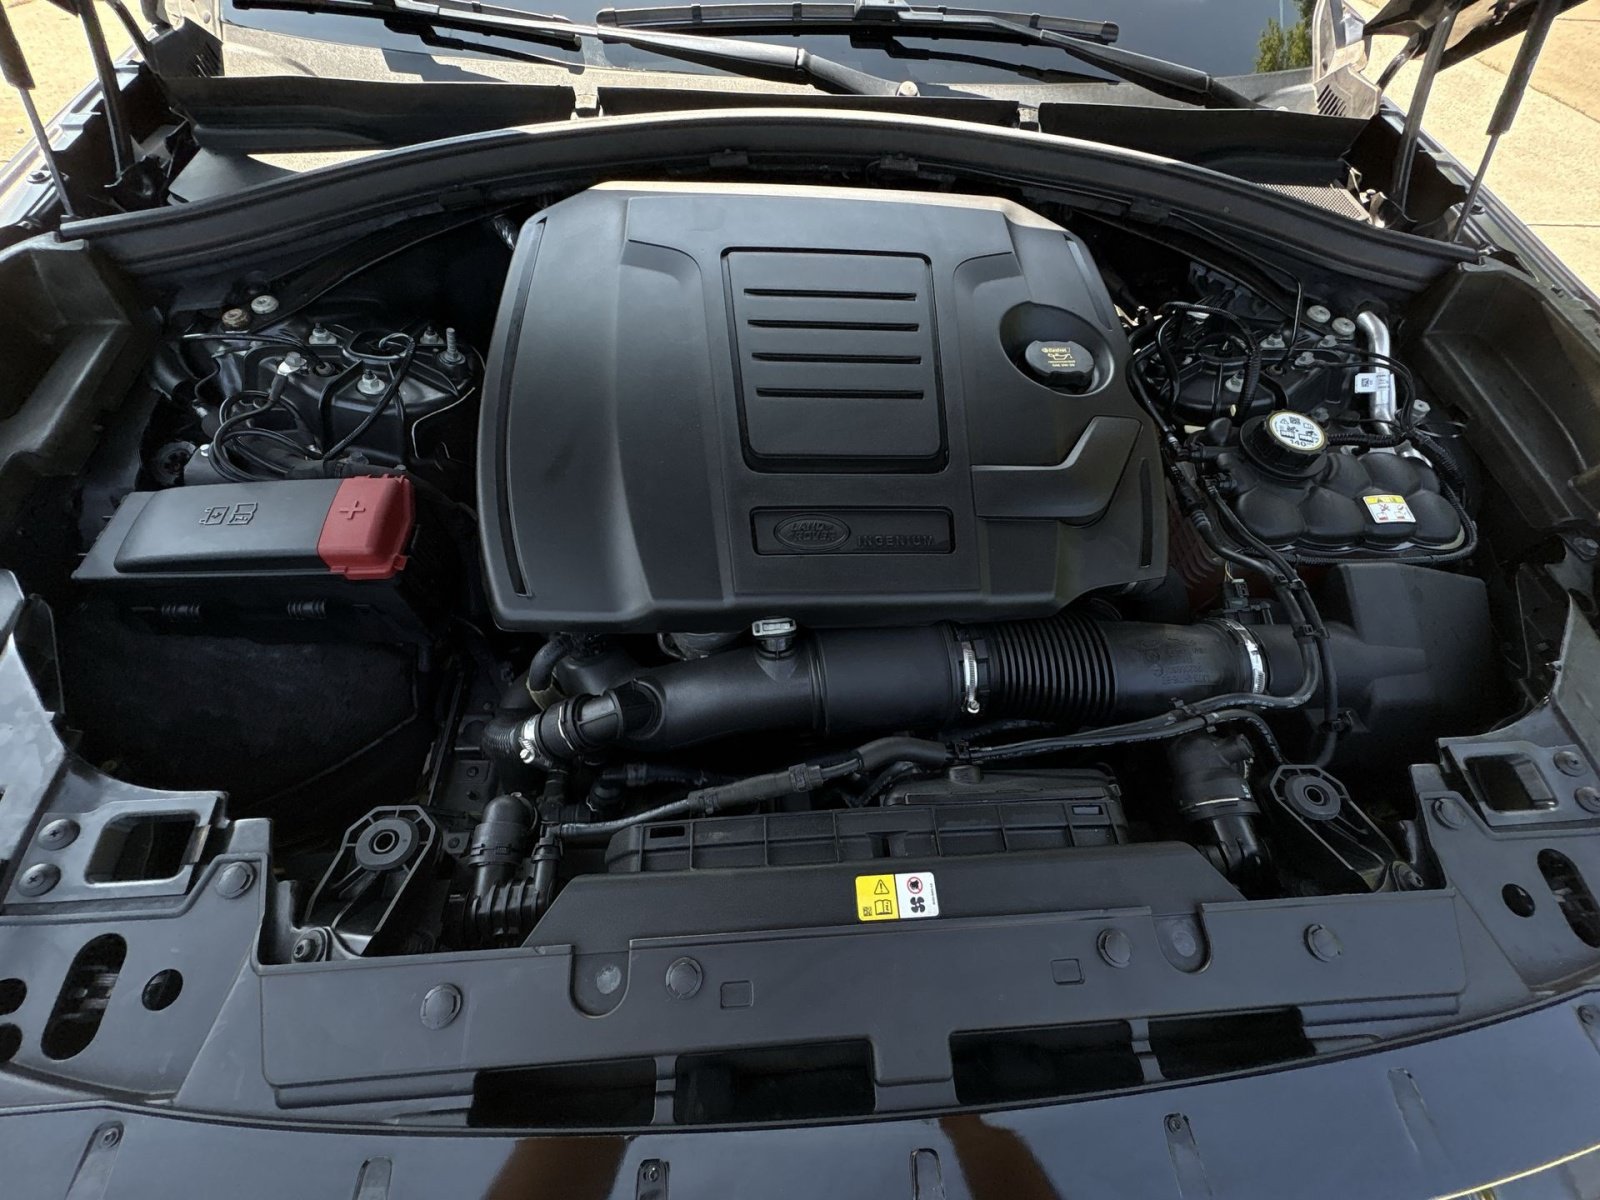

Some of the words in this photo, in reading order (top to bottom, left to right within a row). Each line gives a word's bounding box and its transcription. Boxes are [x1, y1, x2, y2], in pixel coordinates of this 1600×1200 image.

[791, 522, 825, 531] LAND
[795, 531, 837, 541] ROVER
[857, 535, 934, 546] INGENIUM
